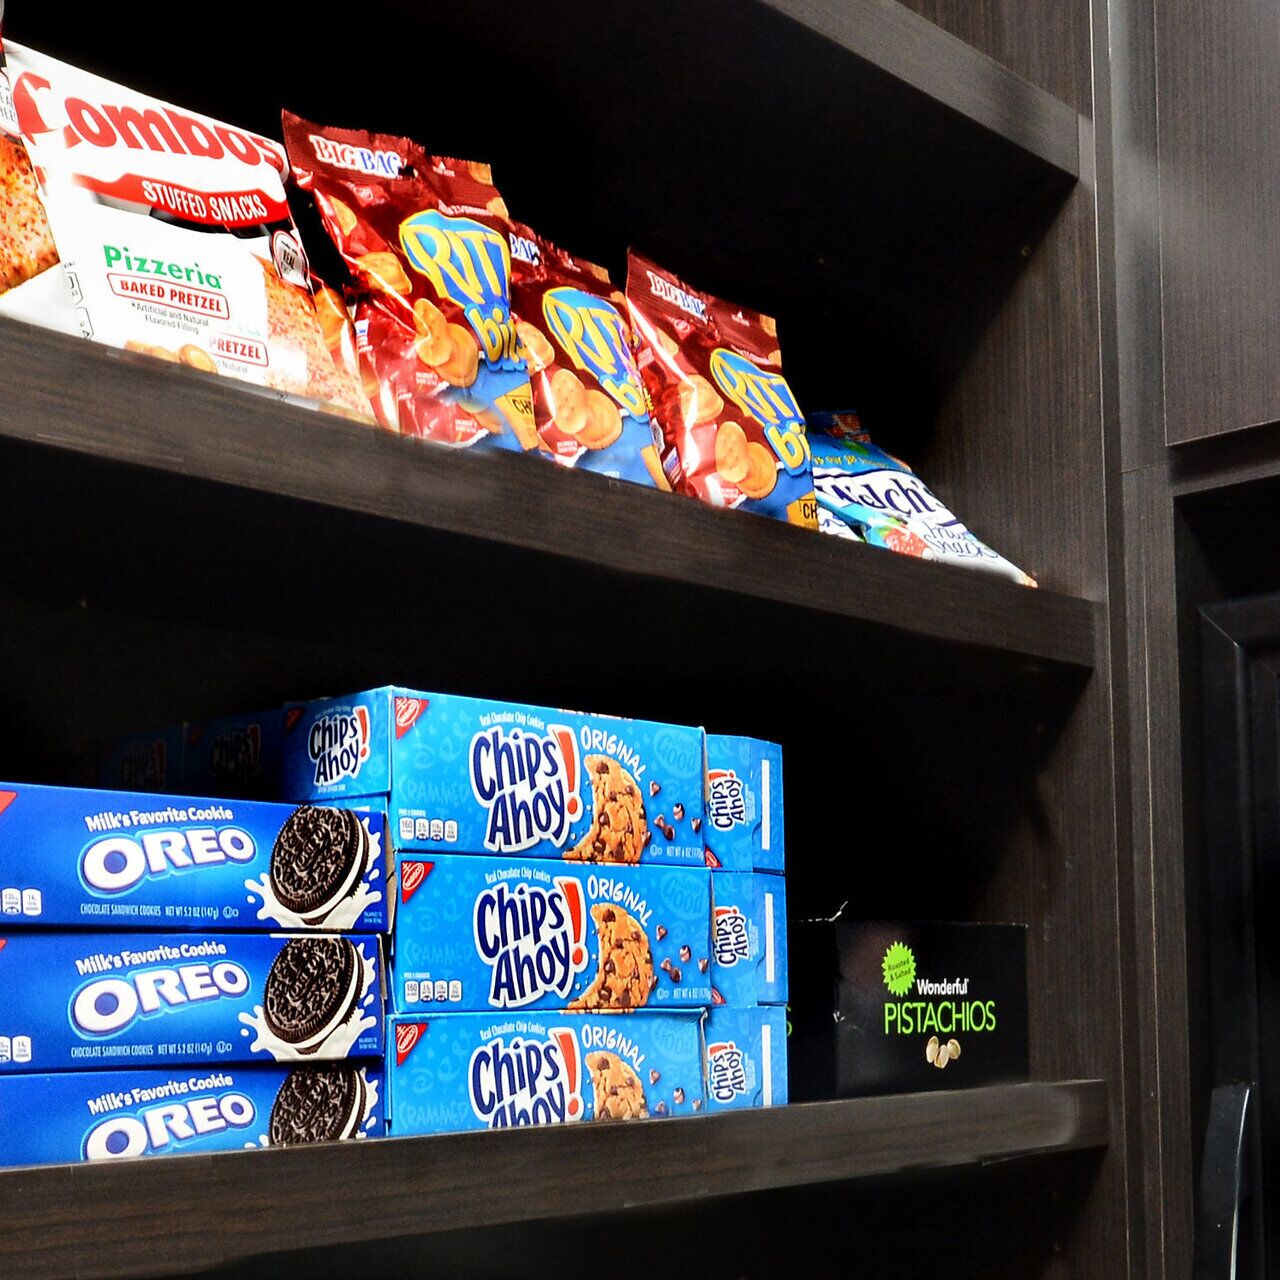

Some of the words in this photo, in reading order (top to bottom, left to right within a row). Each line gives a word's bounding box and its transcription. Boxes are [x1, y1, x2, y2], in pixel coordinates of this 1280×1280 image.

[13, 71, 285, 177] Combos
[309, 134, 357, 168] BIG
[142, 181, 207, 218] STUFFED
[210, 190, 268, 222] SNACKS
[103, 244, 221, 290] Pizzeria
[119, 279, 165, 300] BAKED
[169, 289, 222, 313] PRETZEL
[473, 729, 559, 802] Chips
[580, 725, 646, 782] ORIGINAL
[85, 813, 130, 832] Milk's
[130, 807, 187, 826] Favorite
[187, 806, 233, 820] Cookie
[83, 828, 255, 891] OREO
[497, 870, 520, 883] Chocolate
[533, 870, 551, 884] Cookies
[477, 883, 565, 958] Chips
[587, 874, 653, 927] ORIGINAL
[75, 954, 122, 975] Milk's
[122, 944, 180, 967] Favorite
[181, 941, 226, 958] Cookie
[74, 963, 249, 1032] OREO
[917, 977, 969, 995] Wonderful
[493, 1023, 515, 1038] Chocolate
[528, 1024, 545, 1036] Cookies
[884, 1001, 996, 1035] PISTACHIOS
[580, 1023, 644, 1072] ORIGINAL
[87, 1094, 133, 1116] Milk's
[133, 1084, 189, 1106] Favorite
[190, 1074, 233, 1090] Cookie
[471, 1039, 560, 1115] Chips
[86, 1095, 255, 1160] OREO
